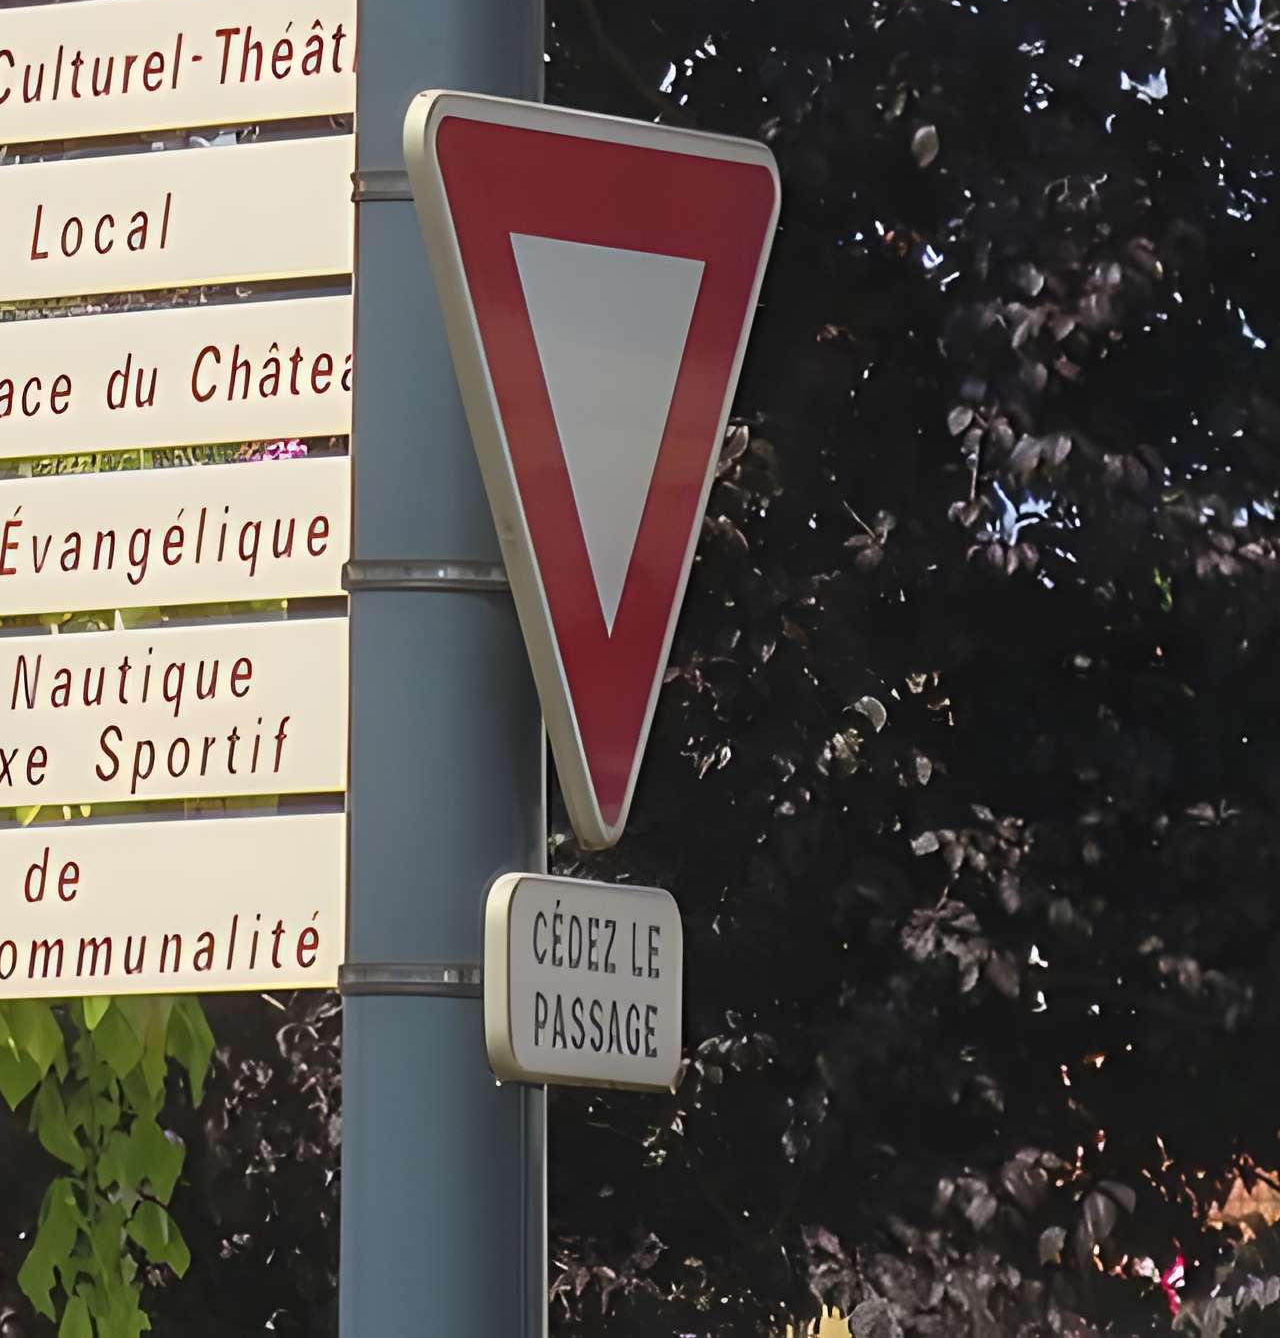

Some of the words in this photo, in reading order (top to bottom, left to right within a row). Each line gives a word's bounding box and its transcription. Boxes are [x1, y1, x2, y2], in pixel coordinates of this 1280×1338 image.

[30, 192, 172, 261] Local
[106, 352, 158, 411] du
[10, 646, 253, 718] Nautique
[95, 715, 292, 795] Sportif
[24, 846, 80, 903] de
[532, 899, 617, 975] CÉDEZ
[631, 921, 661, 979] LE
[534, 991, 658, 1059] PASSAGE
